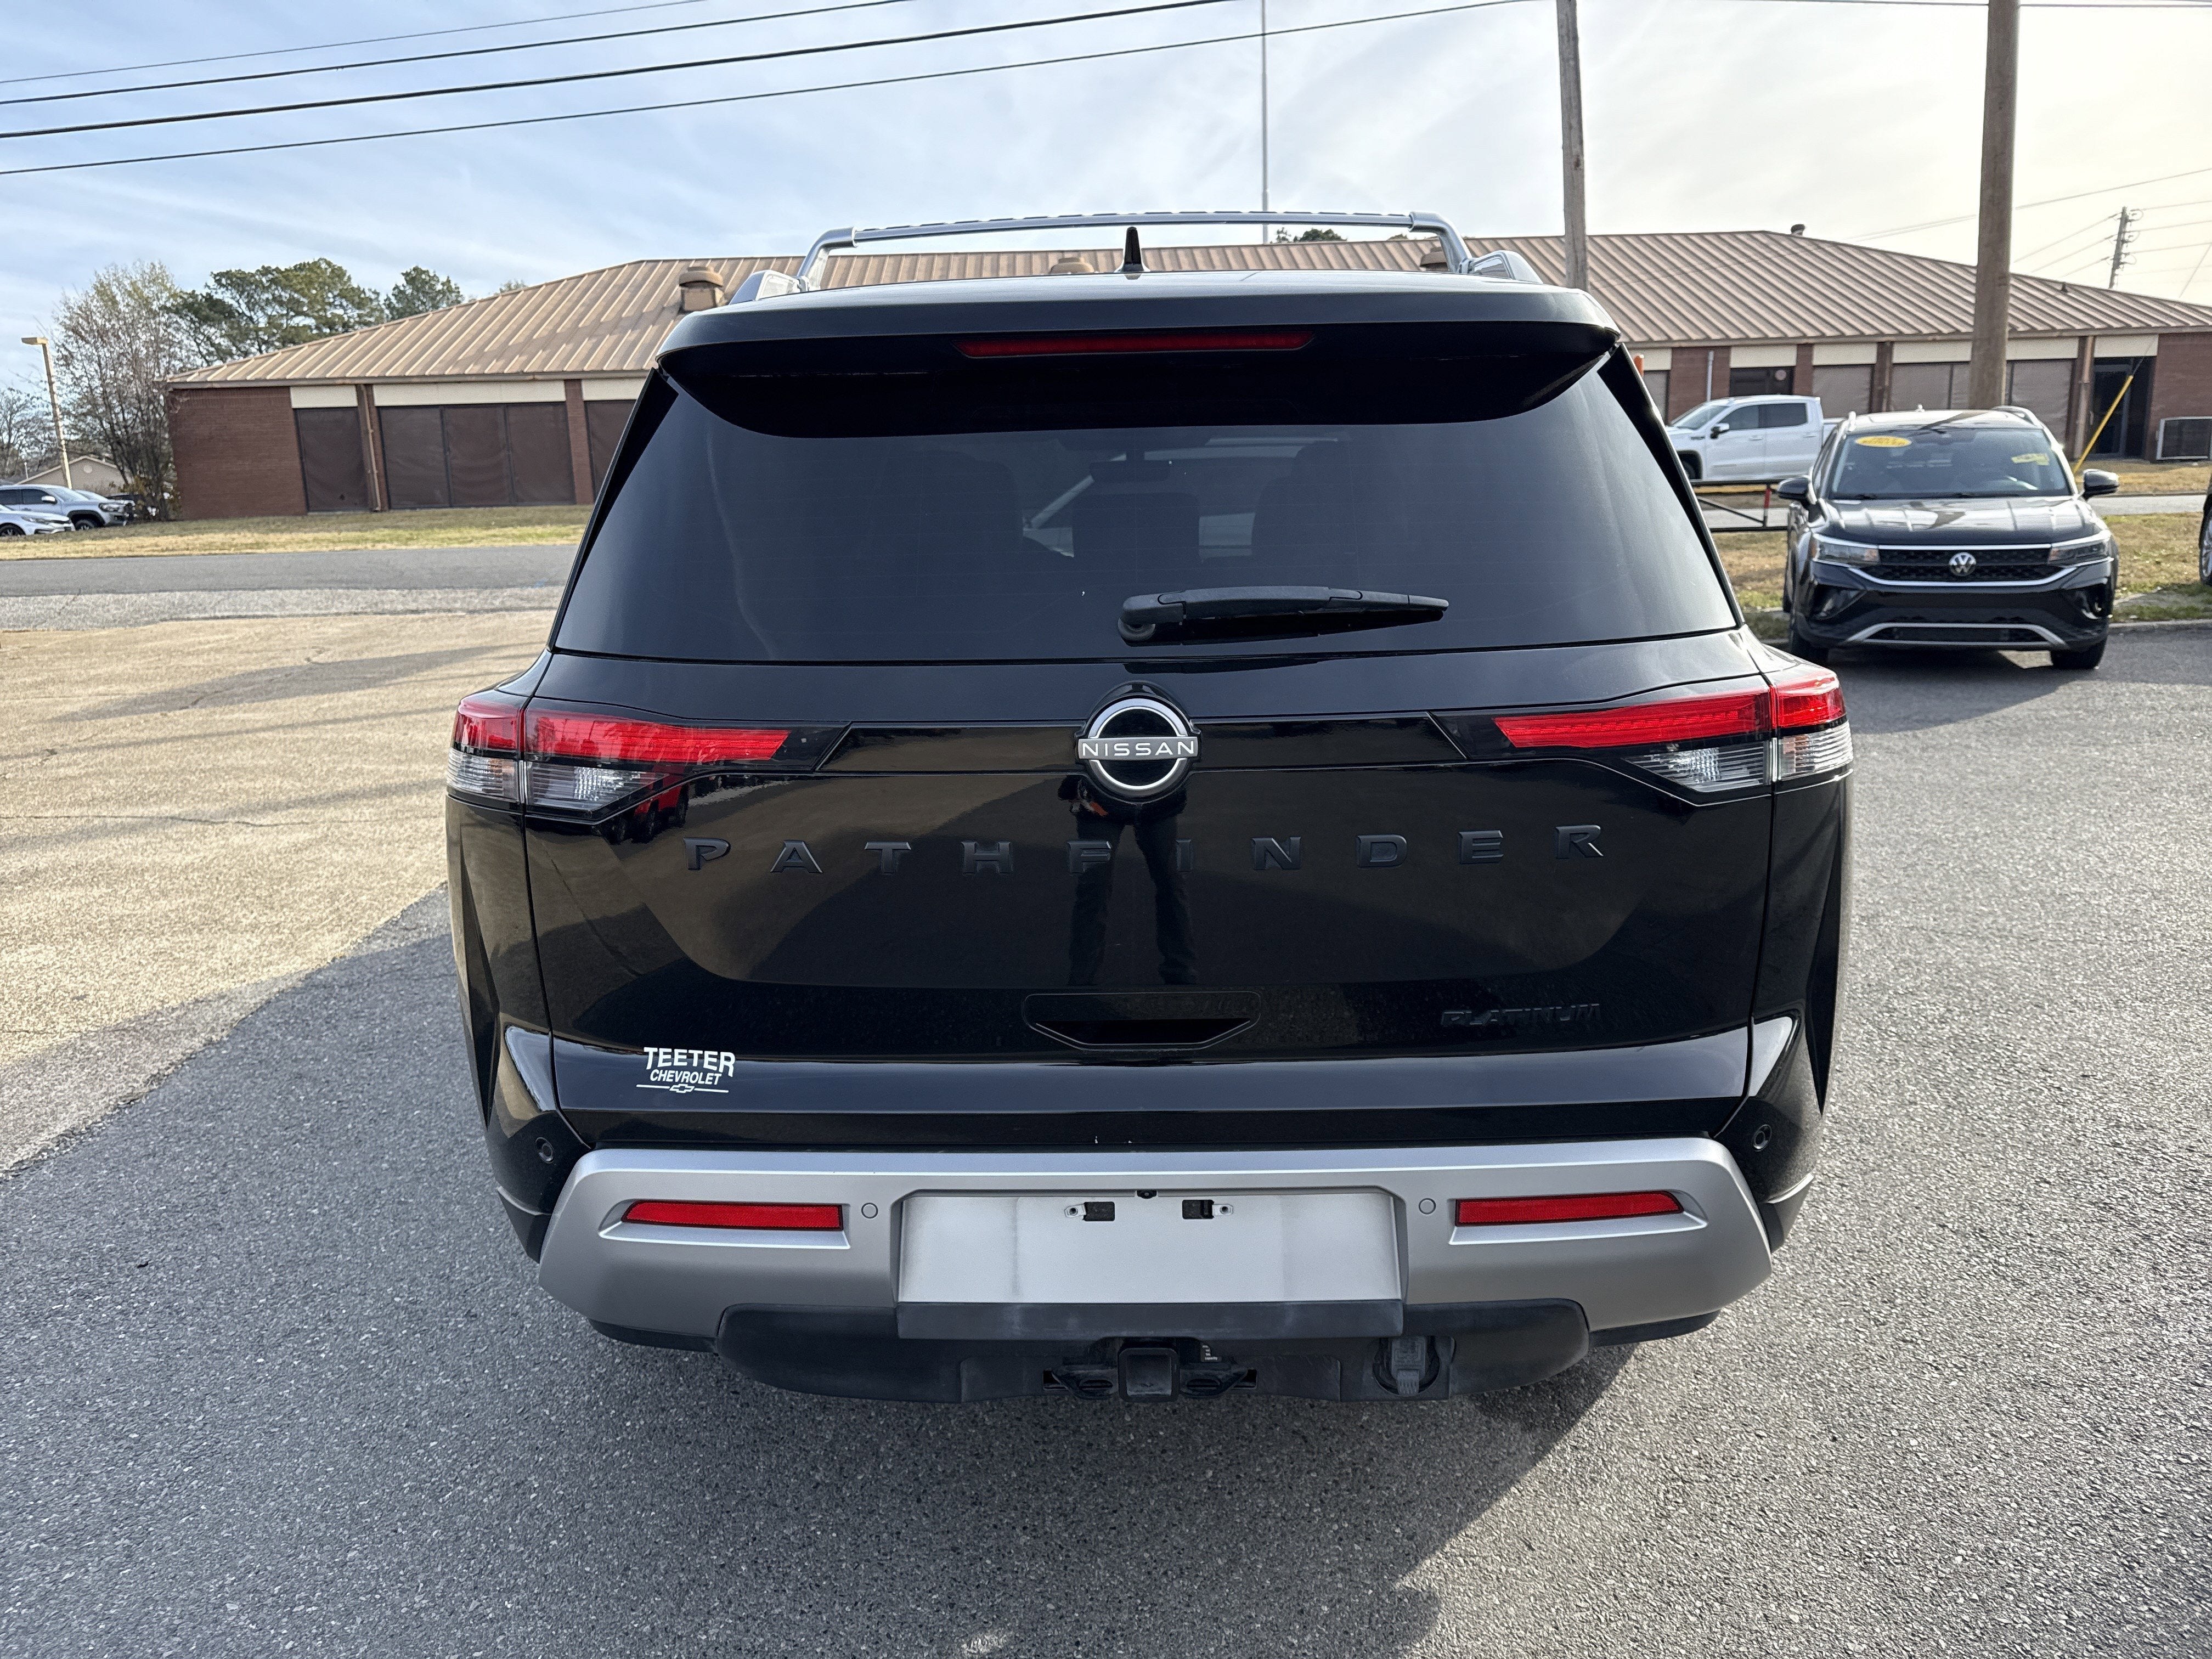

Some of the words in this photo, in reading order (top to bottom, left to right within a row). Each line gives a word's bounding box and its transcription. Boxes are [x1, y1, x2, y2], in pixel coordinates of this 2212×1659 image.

[1082, 741, 1194, 757] NISSAN
[682, 823, 1604, 874] PATHFINDER
[1440, 1003, 1601, 1026] PLATINUM
[644, 1046, 736, 1077] TEETER
[650, 1069, 722, 1085] CHEVROLET
